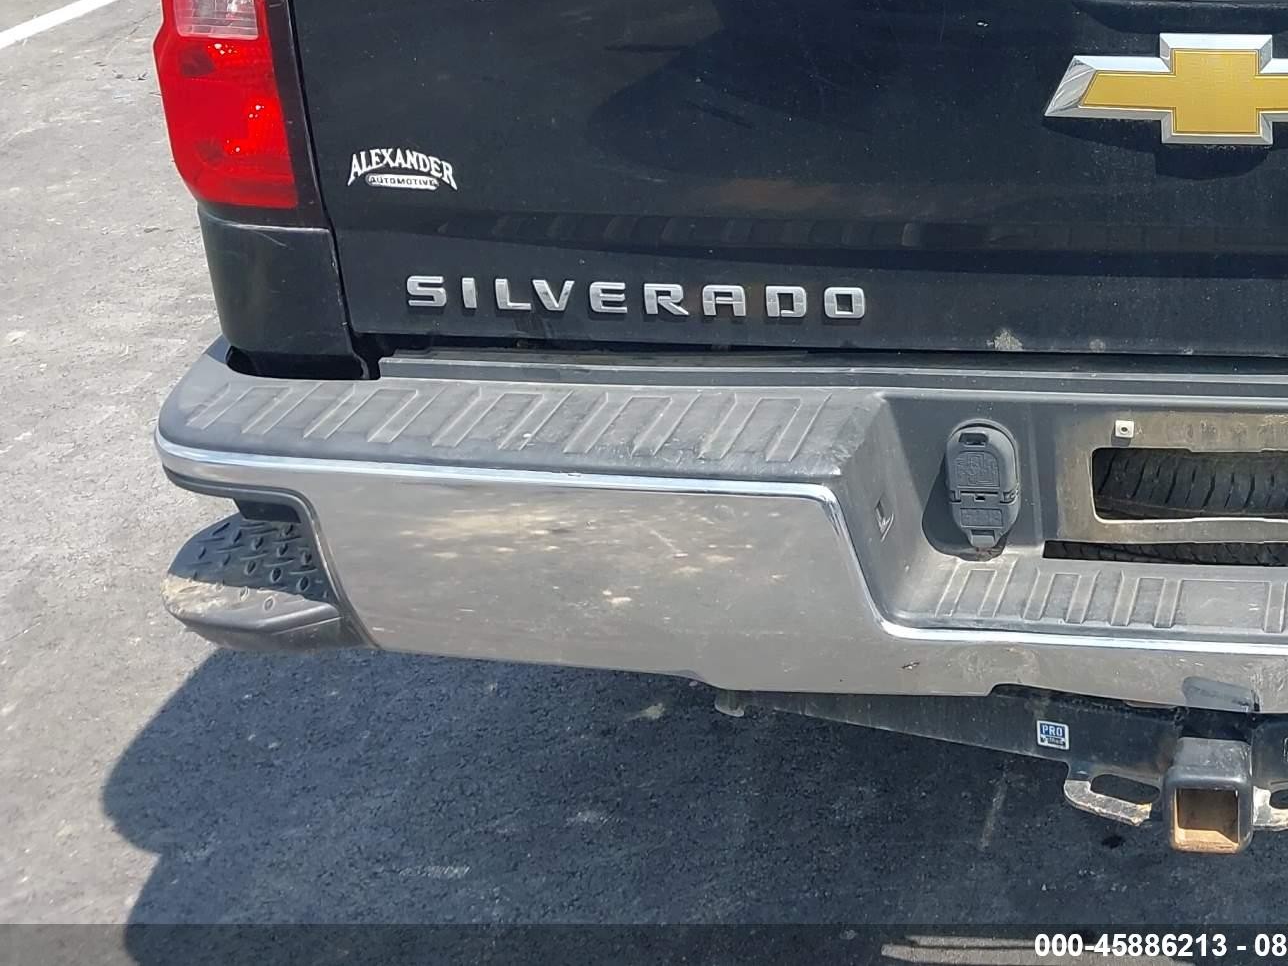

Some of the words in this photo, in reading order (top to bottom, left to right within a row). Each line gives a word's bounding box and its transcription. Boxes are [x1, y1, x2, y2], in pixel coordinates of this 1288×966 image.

[347, 147, 458, 191] ALEXANDER
[368, 176, 438, 187] AUTOMOTIVE
[406, 275, 867, 320] SILVERADO
[1042, 724, 1063, 737] PRO
